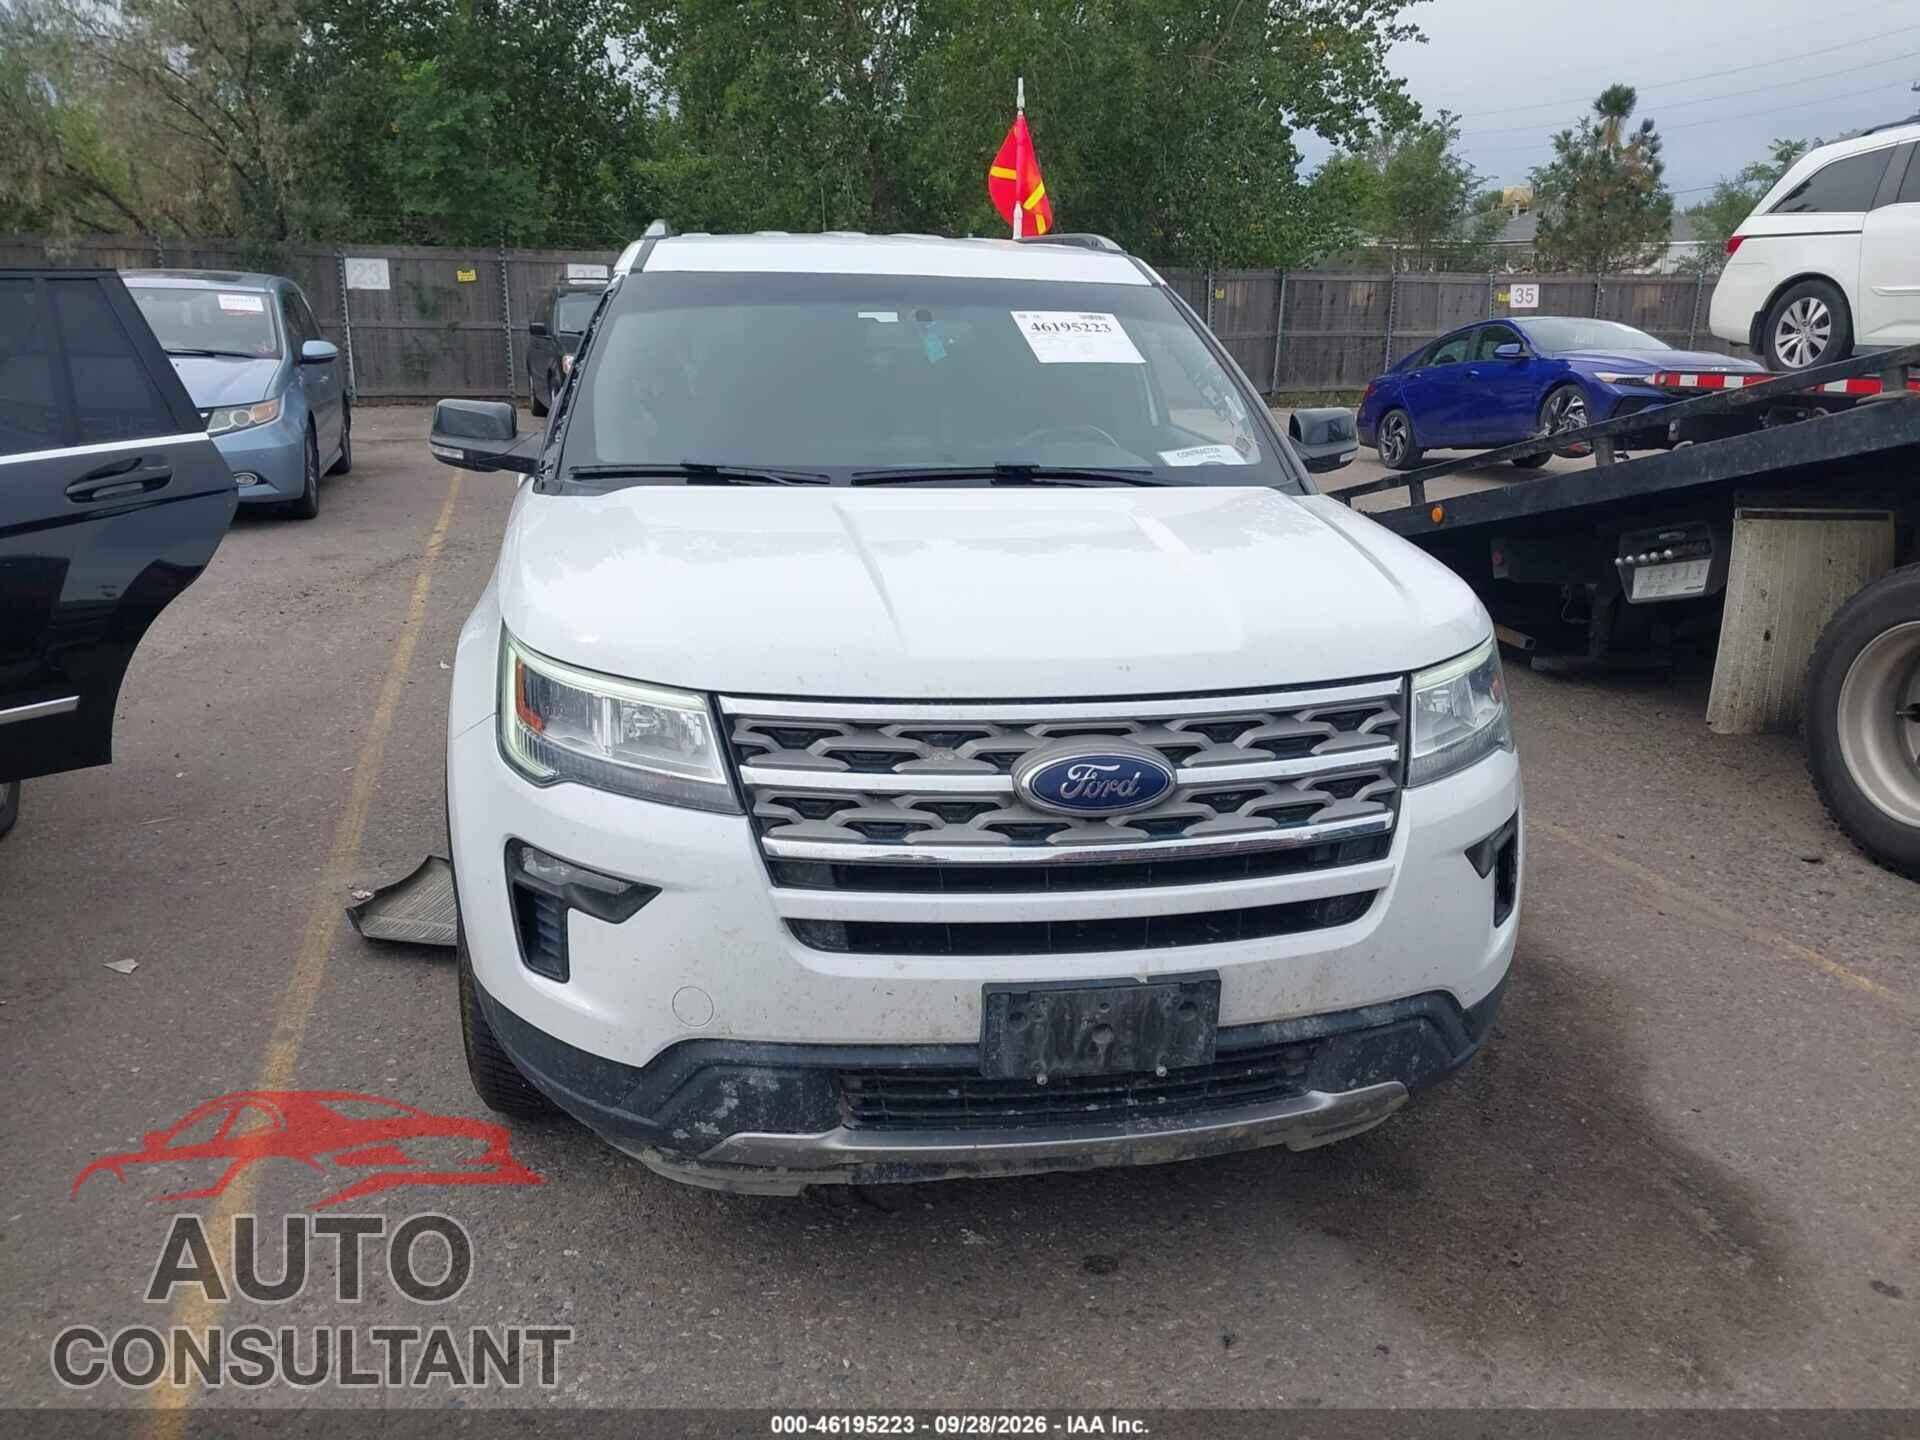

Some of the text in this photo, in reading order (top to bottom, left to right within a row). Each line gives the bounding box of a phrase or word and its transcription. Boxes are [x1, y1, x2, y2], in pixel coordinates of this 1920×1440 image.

[1514, 287, 1534, 304] 35
[1030, 321, 1112, 333] 46195223
[1060, 763, 1141, 799] Ford
